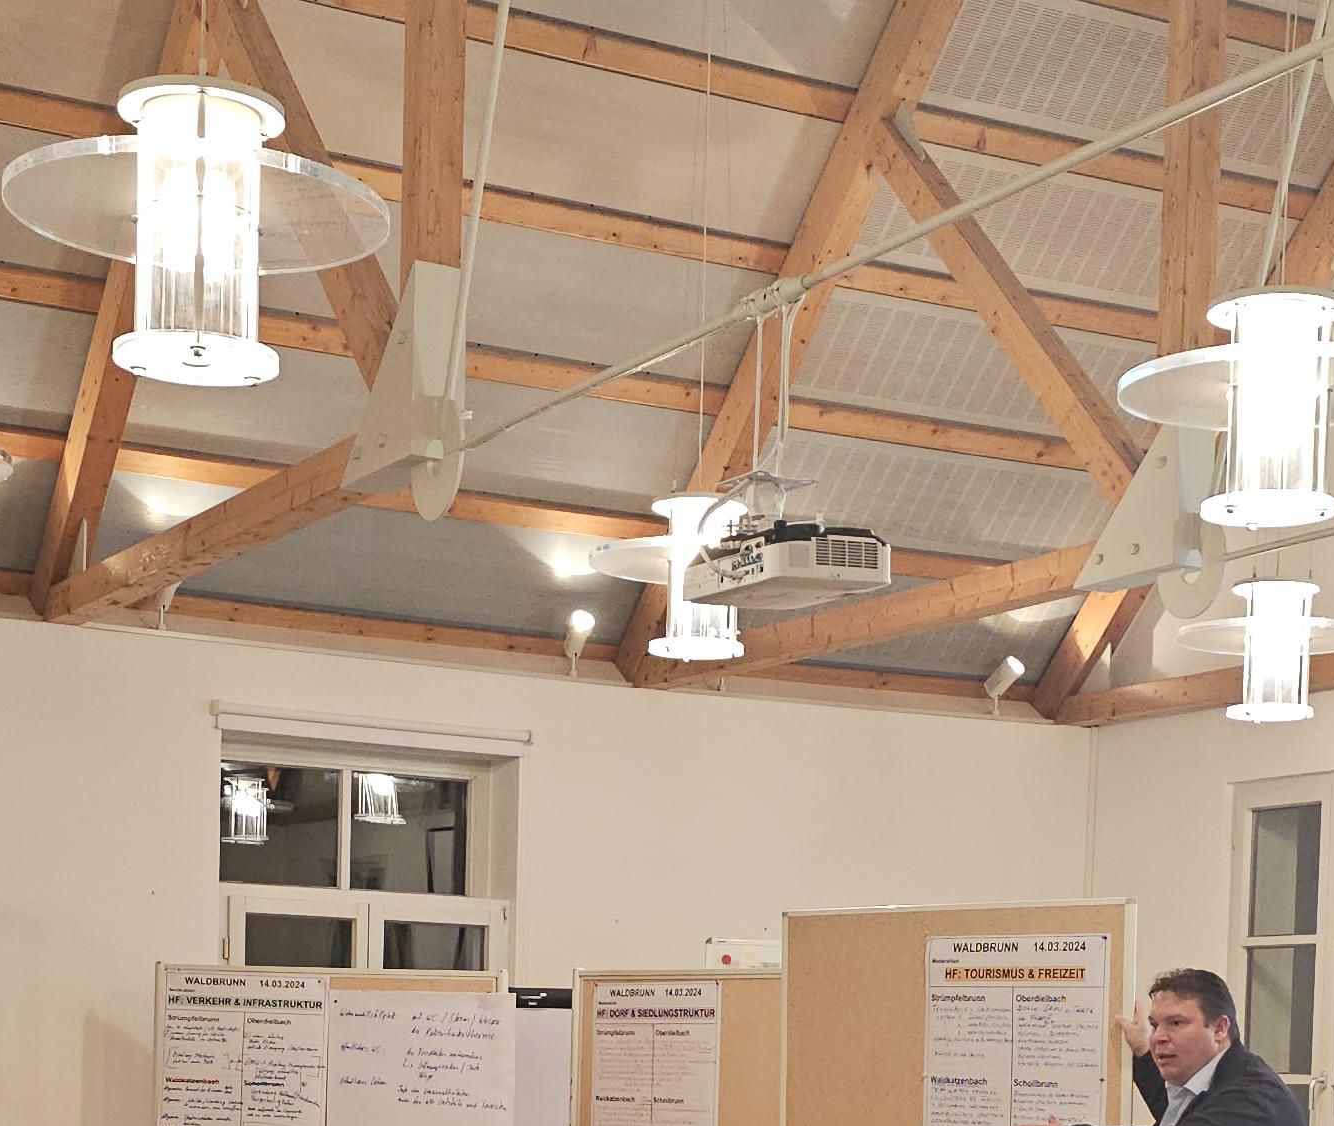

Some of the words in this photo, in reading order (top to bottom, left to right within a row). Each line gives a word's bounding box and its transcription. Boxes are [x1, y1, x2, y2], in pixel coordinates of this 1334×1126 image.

[952, 942, 1019, 953] WALDBRUNN
[1033, 941, 1086, 952] 14.03.2024
[944, 968, 961, 979] HF:
[964, 968, 1025, 979] TOURISMUS
[1027, 969, 1035, 979] &
[1038, 968, 1086, 979] FREIZEIT
[184, 976, 246, 987] WALDBRUNN
[259, 979, 306, 989] 14.03.2024
[609, 988, 656, 997] WALDBRUNN
[664, 988, 702, 997] 14.03.2024
[168, 995, 184, 1005] HF:
[186, 996, 232, 1006] VERKEHR
[233, 998, 241, 1006] &
[242, 998, 323, 1009] INFRASTRUKTUR
[609, 1008, 629, 1018] DORF
[630, 1008, 636, 1018] &
[637, 1008, 716, 1018] SIEDLUNGSTRUKTUR
